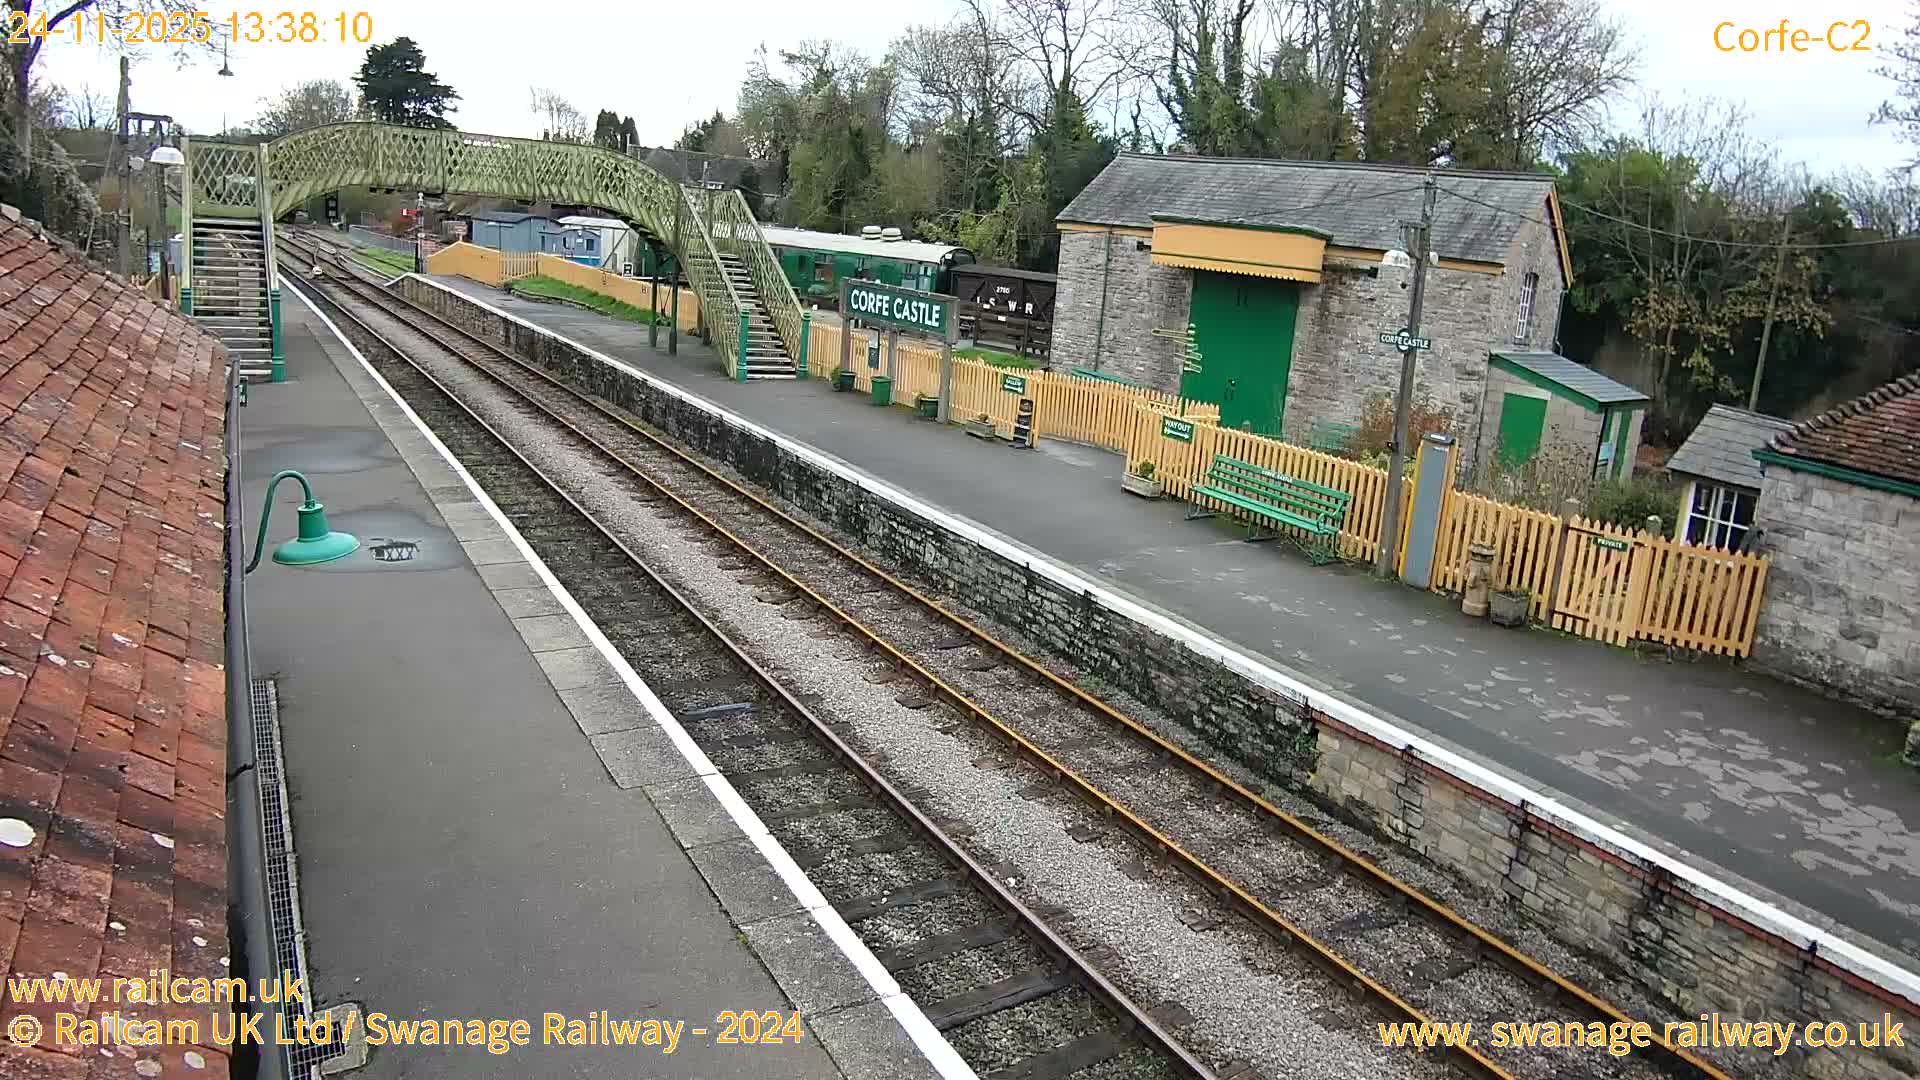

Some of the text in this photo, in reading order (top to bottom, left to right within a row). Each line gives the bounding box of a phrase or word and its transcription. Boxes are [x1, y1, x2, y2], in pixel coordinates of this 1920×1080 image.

[850, 288, 941, 328] CORFE CASTLE
[1381, 334, 1429, 349] CORFE CASTLE
